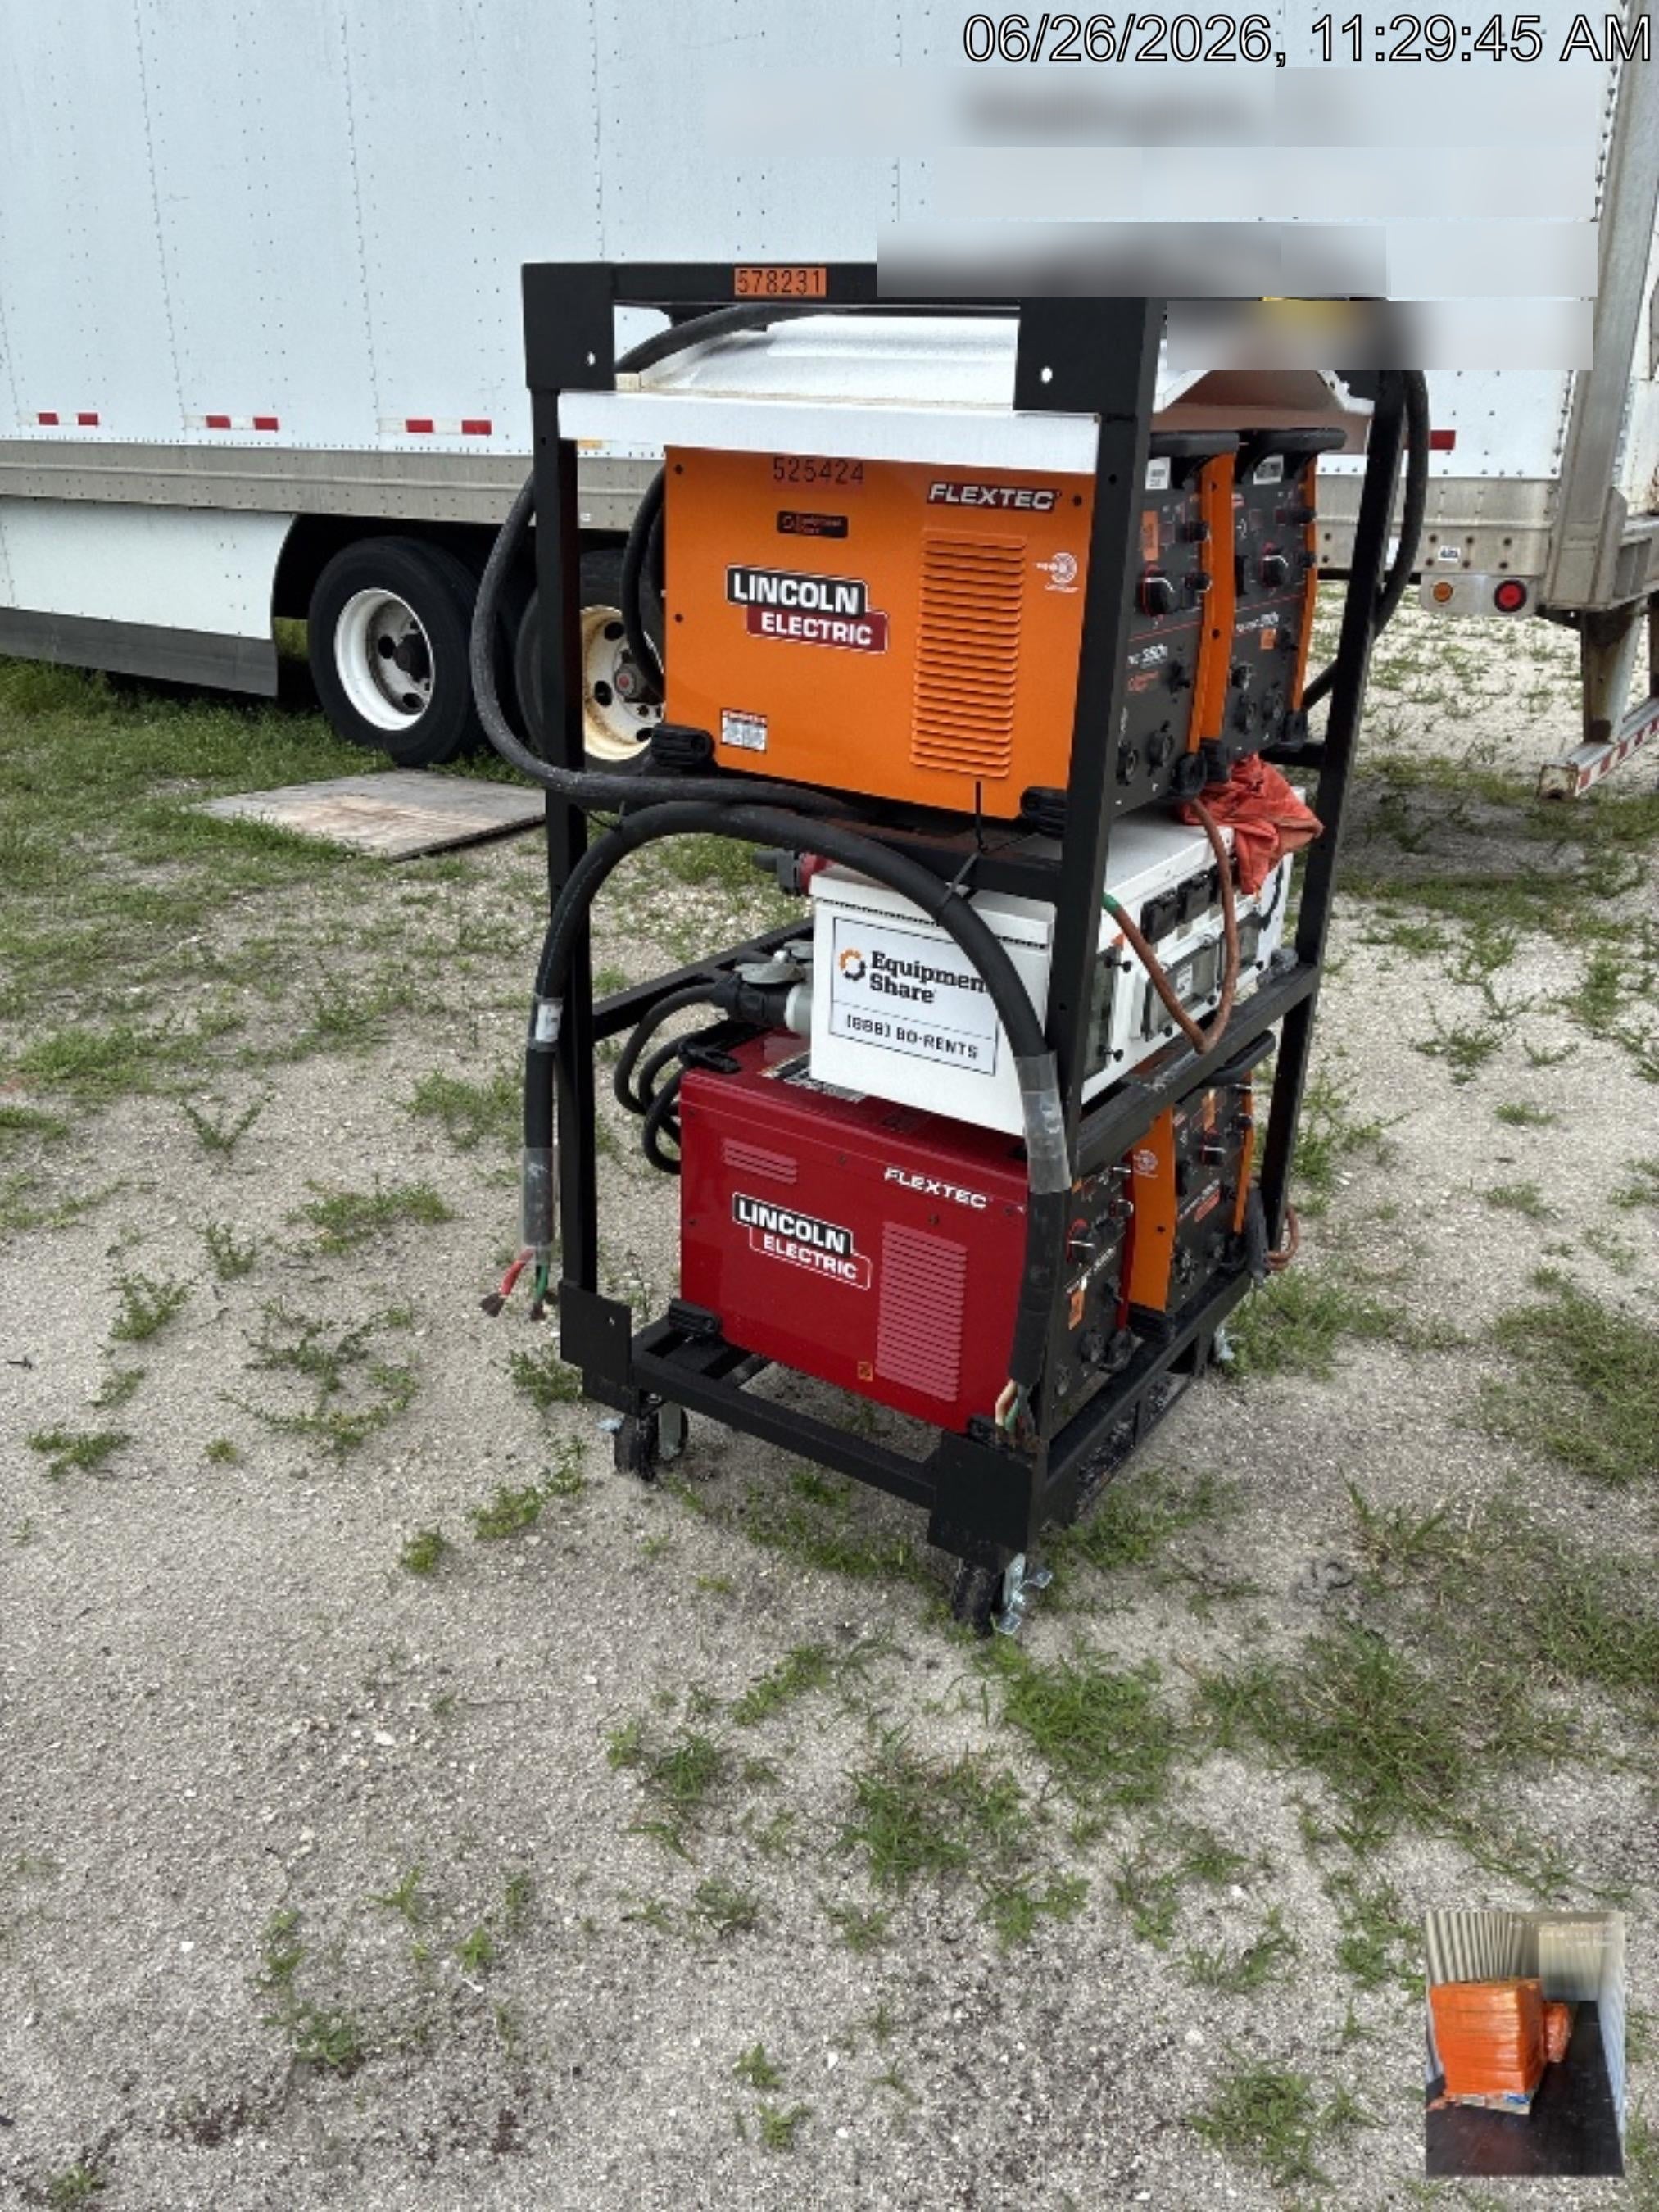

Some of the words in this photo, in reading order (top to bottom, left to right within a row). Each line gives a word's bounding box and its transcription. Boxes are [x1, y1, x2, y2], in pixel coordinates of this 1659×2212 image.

[737, 269, 820, 295] 578231
[773, 456, 864, 485] 525424
[928, 482, 1054, 510] FLEXTEC
[733, 573, 859, 615] LINCOLN
[760, 610, 873, 646] ELECTRIC
[869, 972, 934, 1004] Share
[871, 950, 990, 994] Equipmen
[884, 1167, 987, 1209] FLEXTEC
[738, 1199, 845, 1255] LINCOLN
[763, 1232, 858, 1280] ELECTRIC
